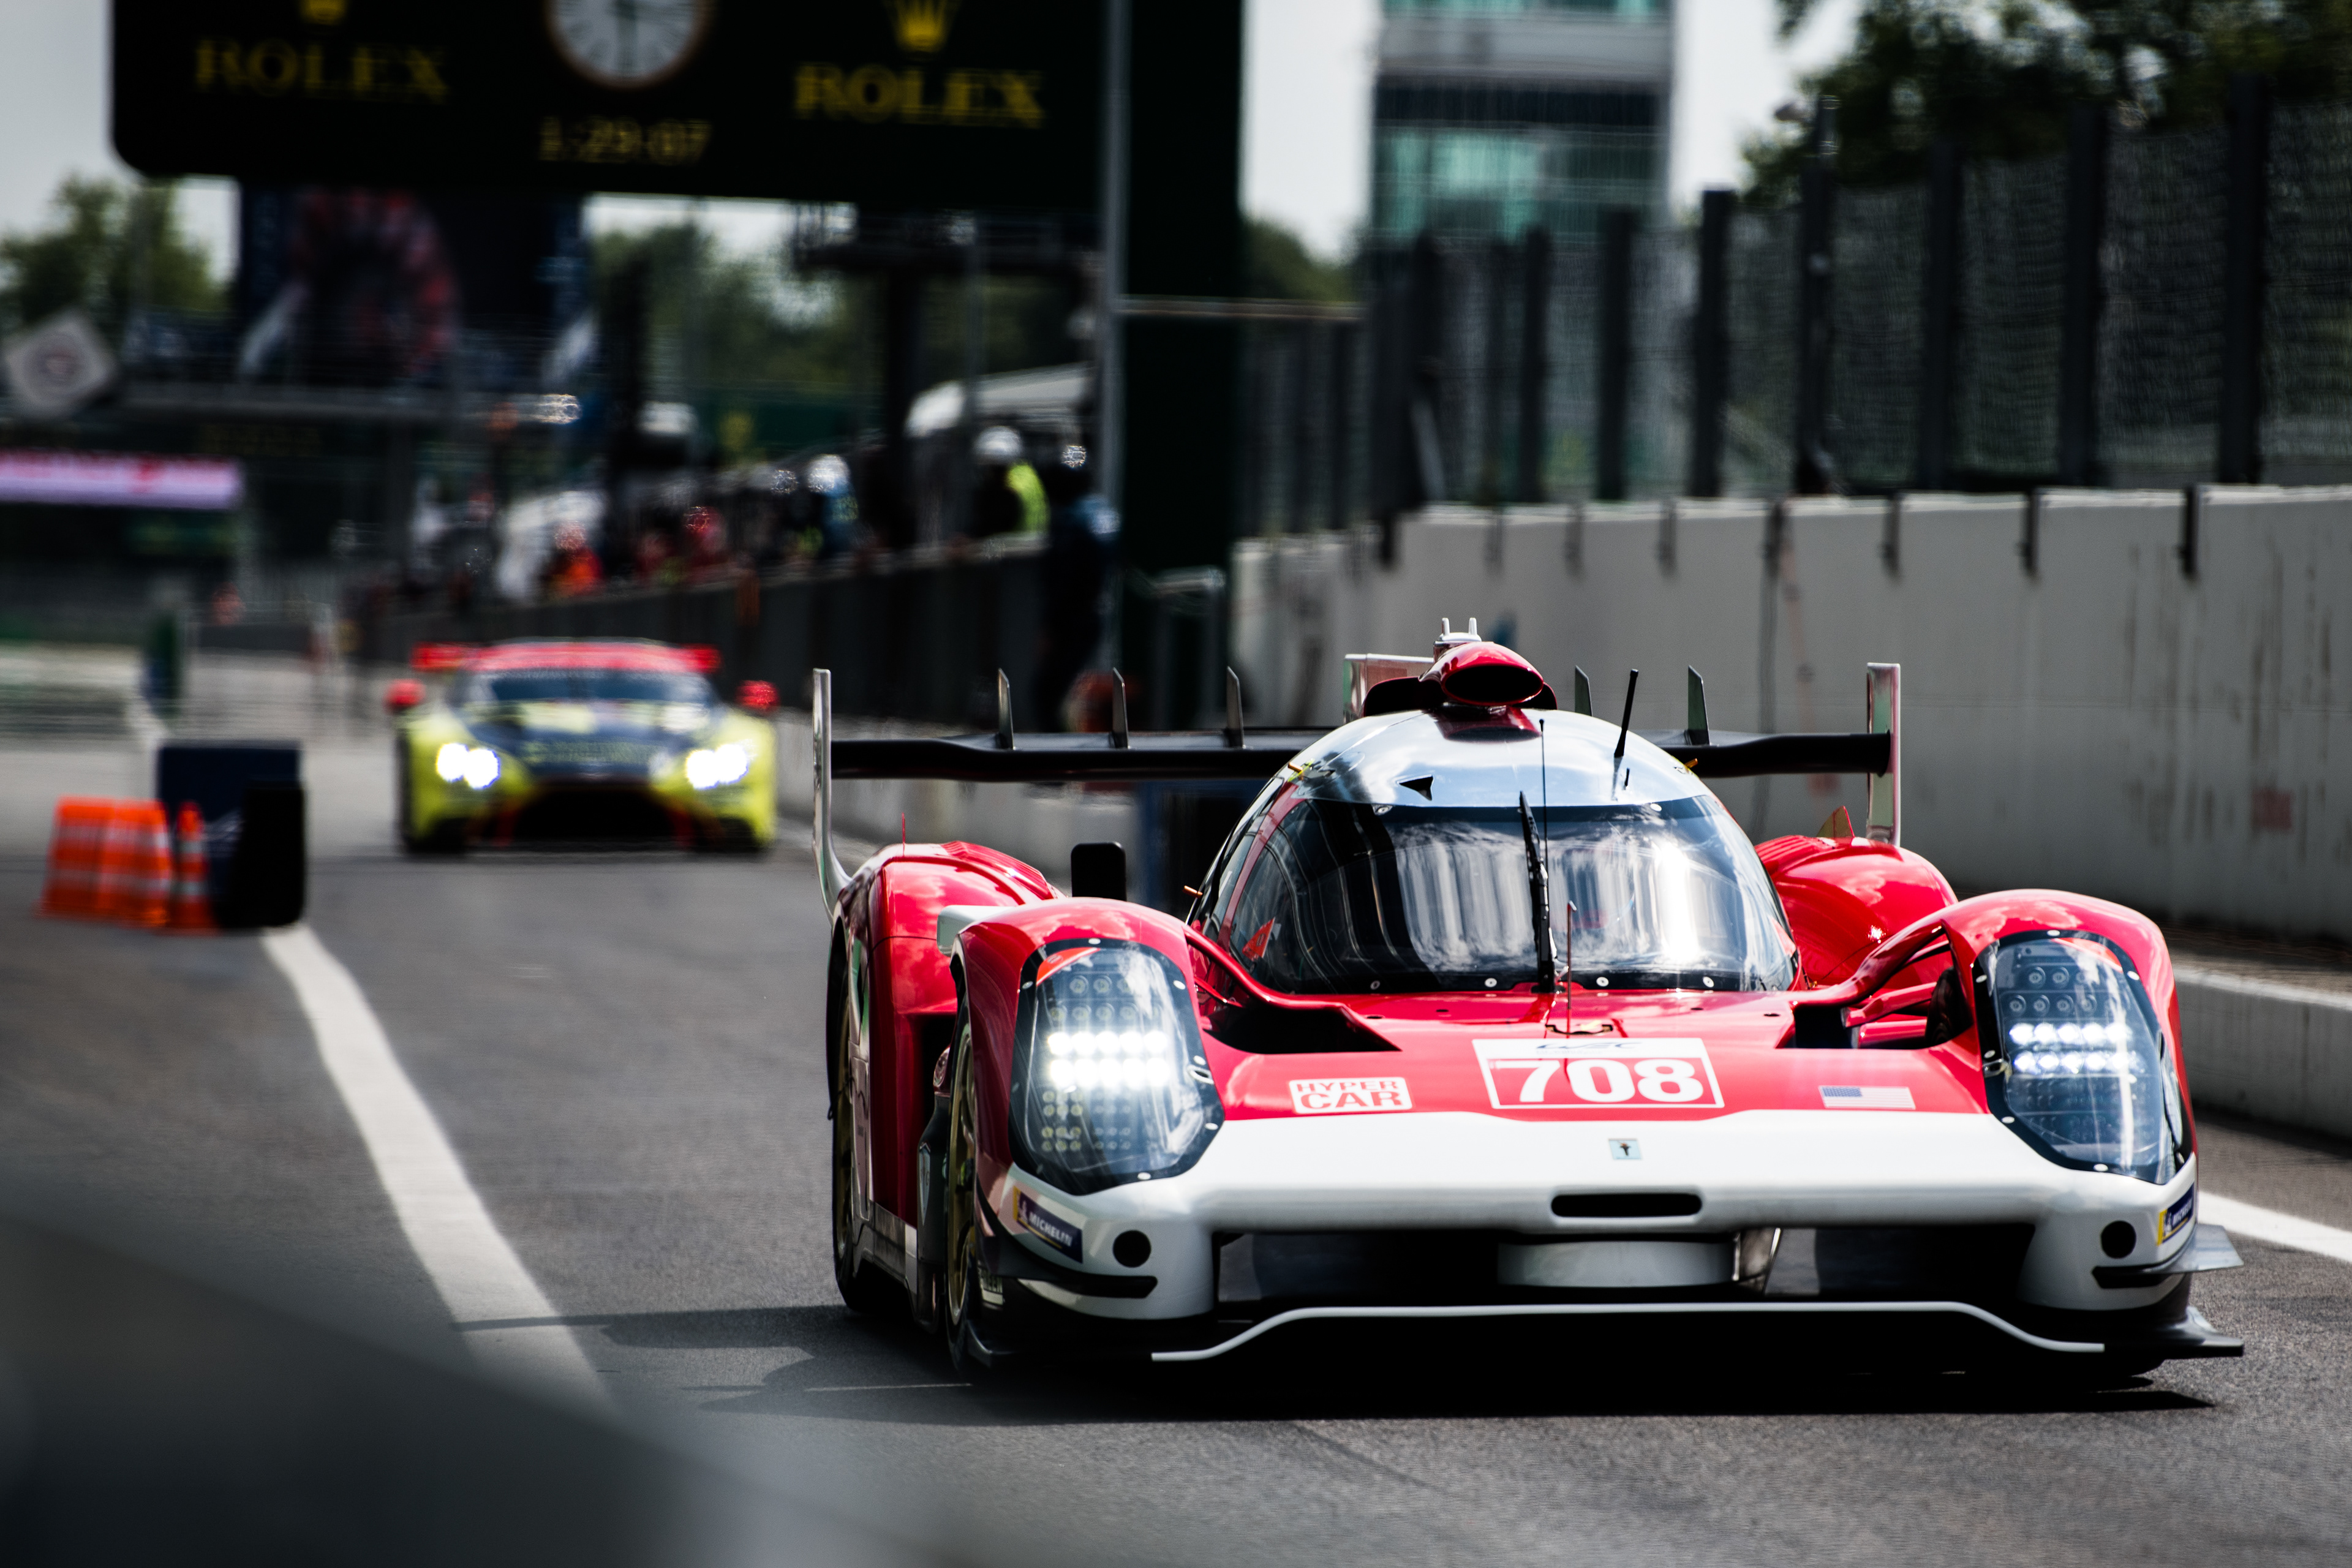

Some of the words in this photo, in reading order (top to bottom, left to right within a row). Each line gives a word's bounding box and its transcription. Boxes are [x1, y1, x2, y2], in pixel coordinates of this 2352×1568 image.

[194, 34, 451, 104] ROLEX
[793, 61, 1047, 129] ROLEX
[1297, 1080, 1398, 1093] HYPER
[1490, 1059, 1704, 1102] 708
[1300, 1091, 1403, 1109] CAR
[1029, 1213, 1073, 1247] MICHELIN
